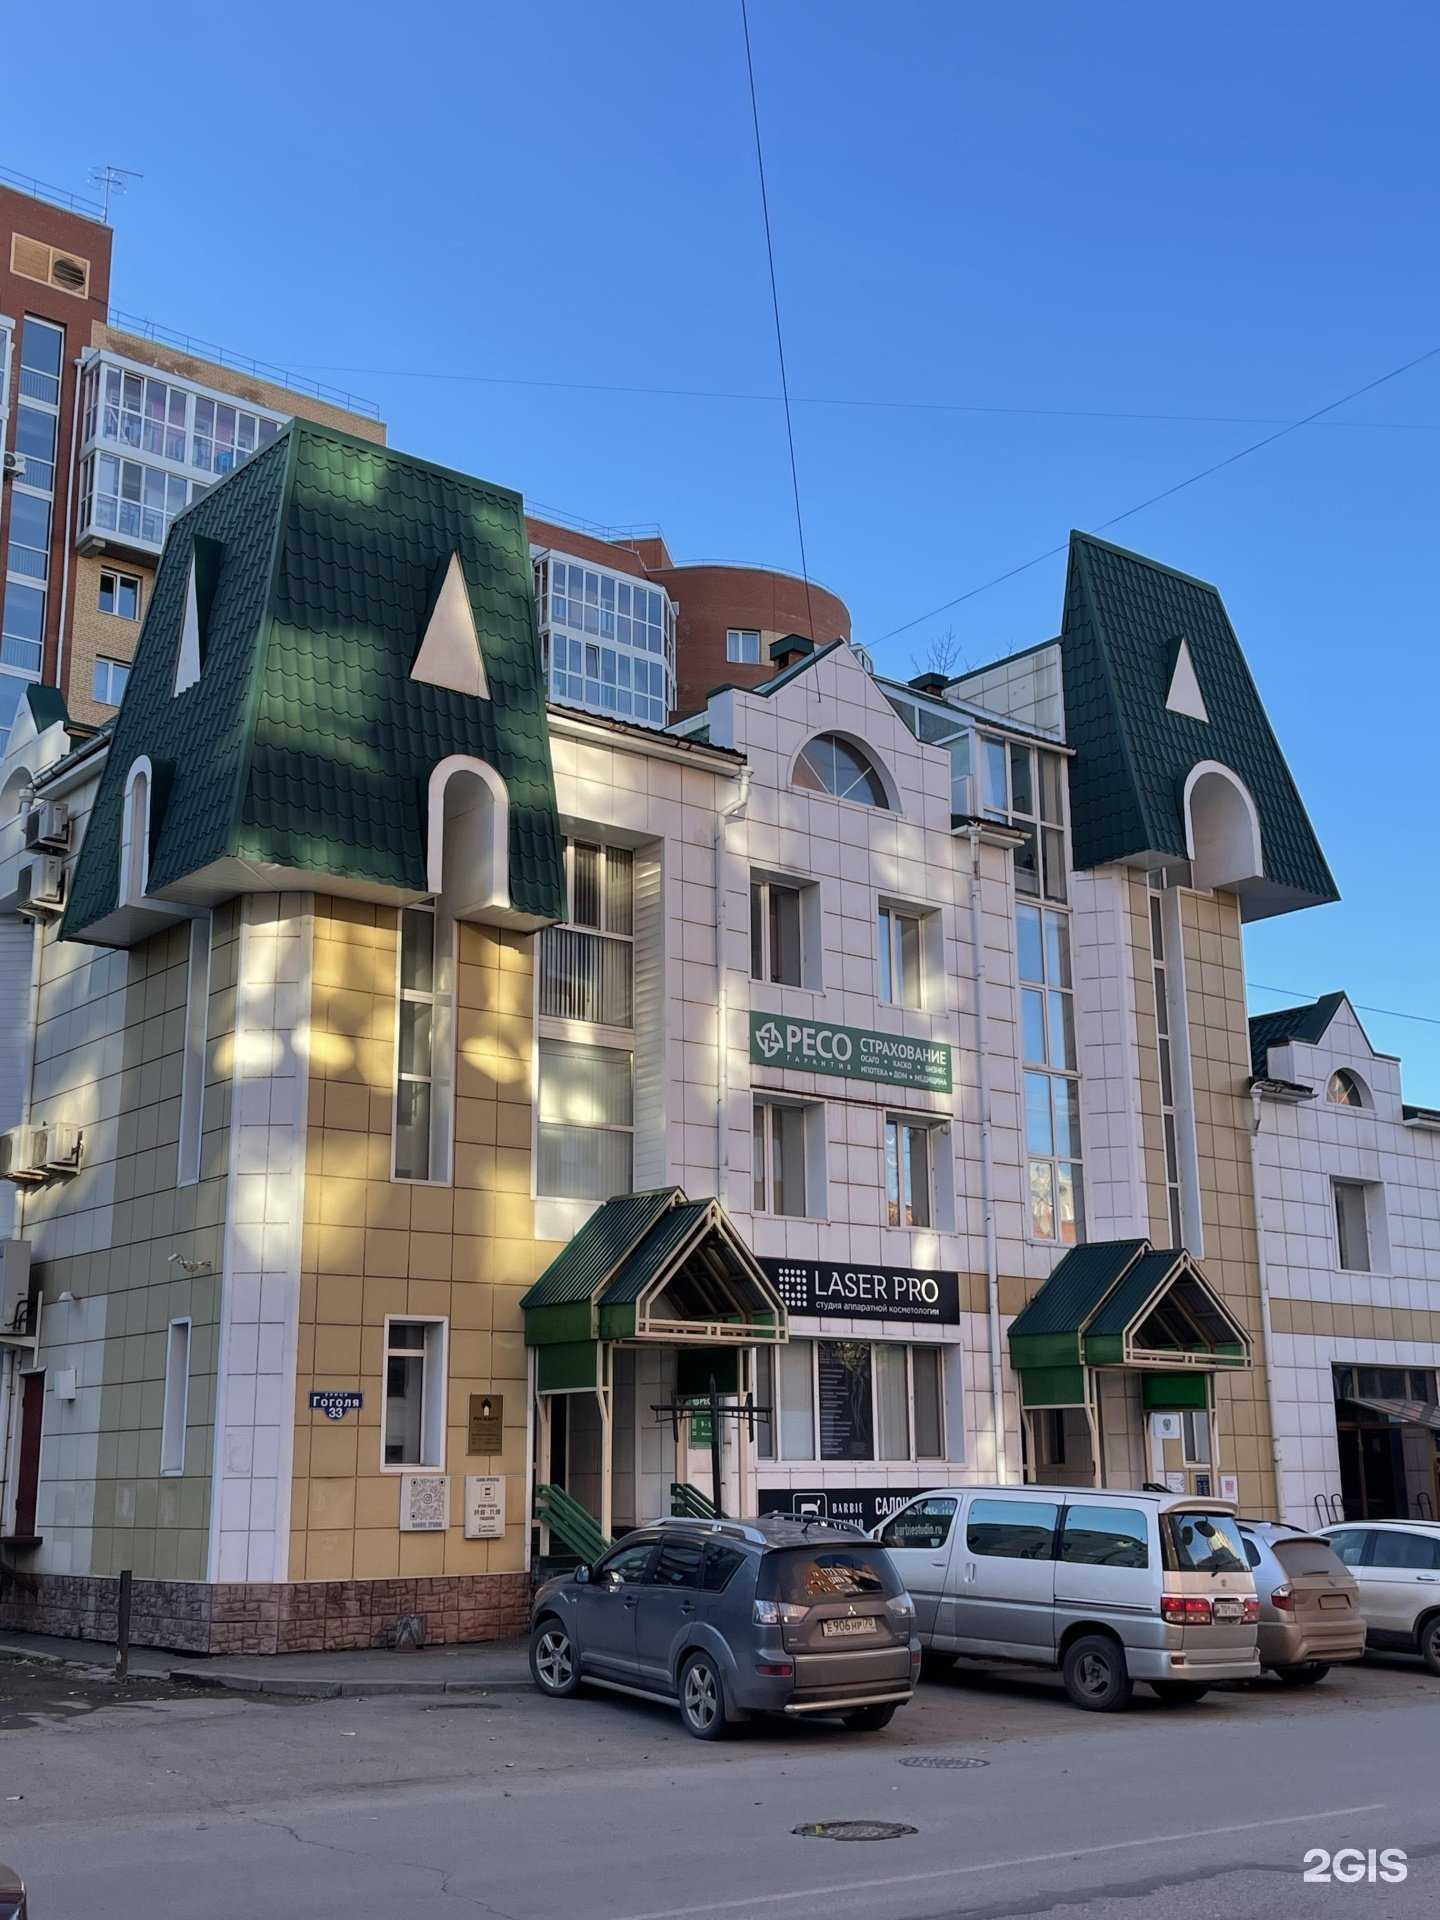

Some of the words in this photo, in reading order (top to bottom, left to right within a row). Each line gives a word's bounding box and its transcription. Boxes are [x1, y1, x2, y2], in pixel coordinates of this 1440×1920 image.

[786, 1024, 852, 1061] РЕСО
[860, 1038, 947, 1065] СТРАХОВАНИЕ
[786, 1055, 851, 1070] ГАРАНТИЯ
[860, 1055, 880, 1064] ОСАГО
[893, 1060, 912, 1070] КАСКО
[860, 1066, 889, 1077] ИПОТЕКА
[893, 1071, 908, 1079] ДОМ
[815, 1270, 887, 1299] LASER
[893, 1276, 939, 1303] PRO
[815, 1301, 842, 1311] студия
[843, 1302, 887, 1314] аппаратной
[888, 1305, 940, 1316] косметологии
[313, 1396, 360, 1407] Гоголя
[328, 1407, 343, 1418] 33
[832, 1502, 863, 1514] BARBIE
